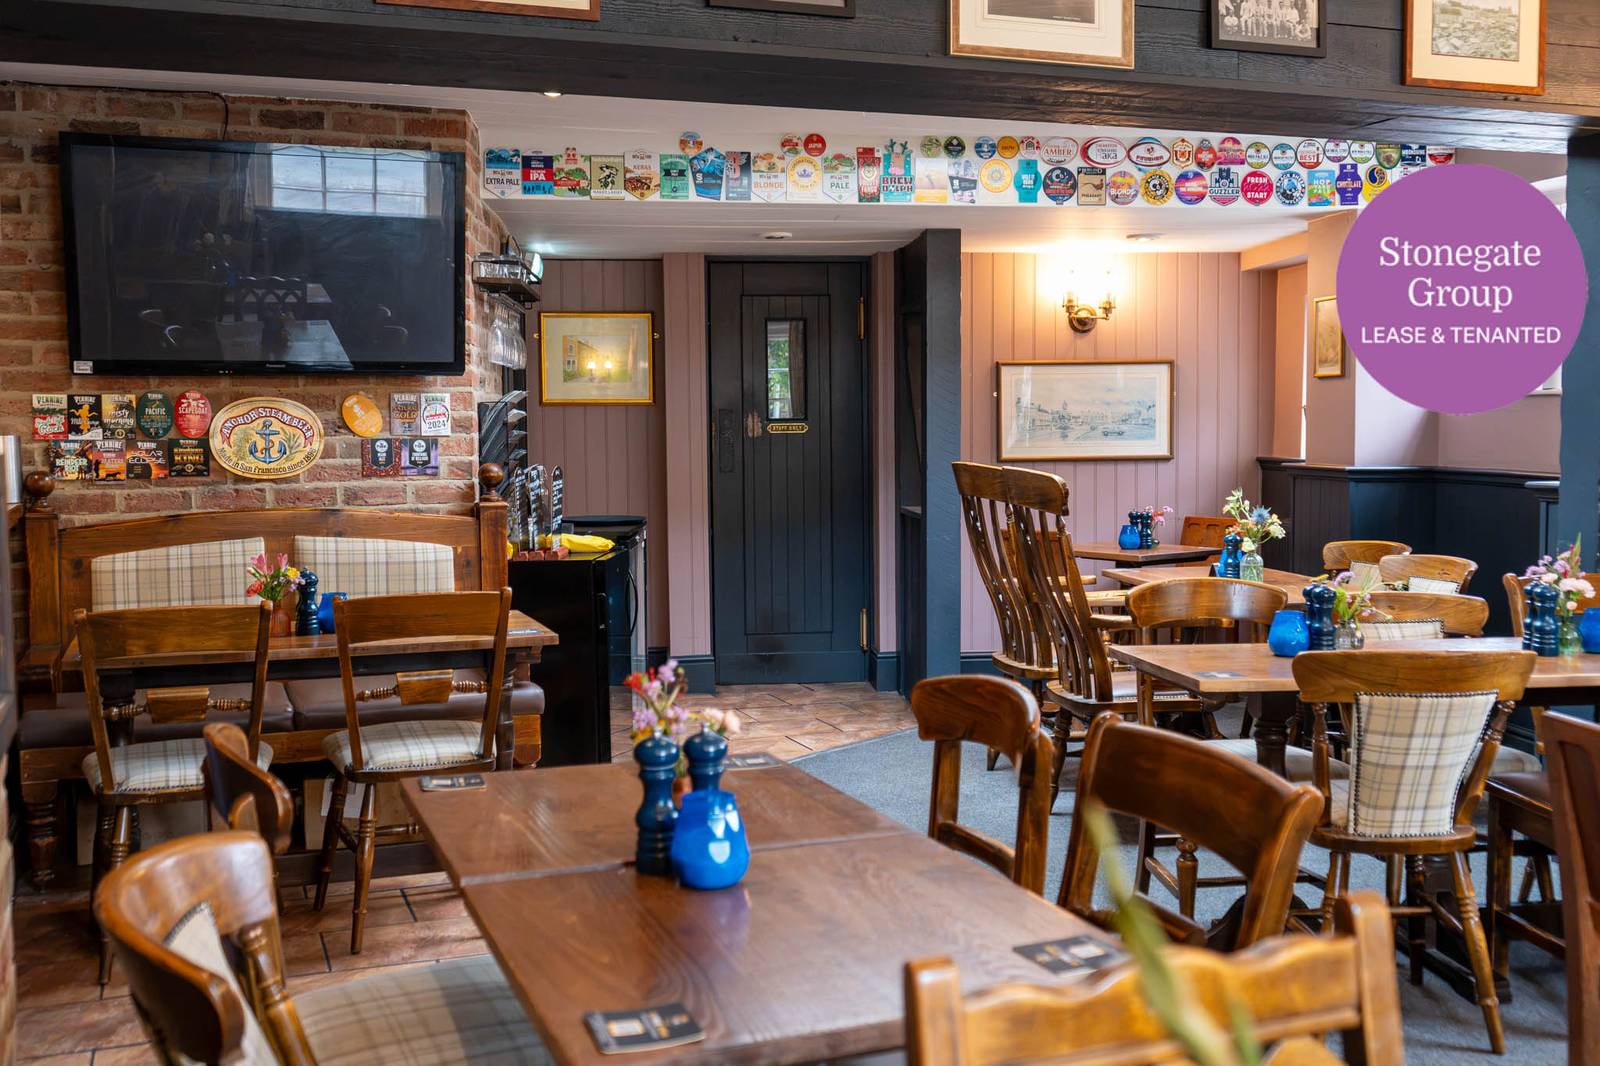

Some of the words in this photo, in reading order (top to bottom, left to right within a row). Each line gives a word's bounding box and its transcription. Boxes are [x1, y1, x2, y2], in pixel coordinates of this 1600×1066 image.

[1045, 148, 1072, 156] AMBER
[530, 173, 546, 181] IPA
[486, 177, 505, 185] EXTRA
[505, 178, 521, 186] PALE
[145, 407, 166, 415] PACIFIC
[178, 407, 209, 415] SCAPEGOAT
[222, 409, 258, 437] ANCHOR
[258, 407, 290, 425] STEAM
[292, 418, 314, 439] BEER
[427, 420, 447, 430] 2024
[131, 450, 164, 458] SOLAR
[128, 457, 167, 465] ECLIPSE
[217, 447, 232, 466] Made
[231, 461, 239, 469] in
[240, 463, 253, 473] San
[253, 466, 287, 474] Francisco
[287, 460, 305, 472] since
